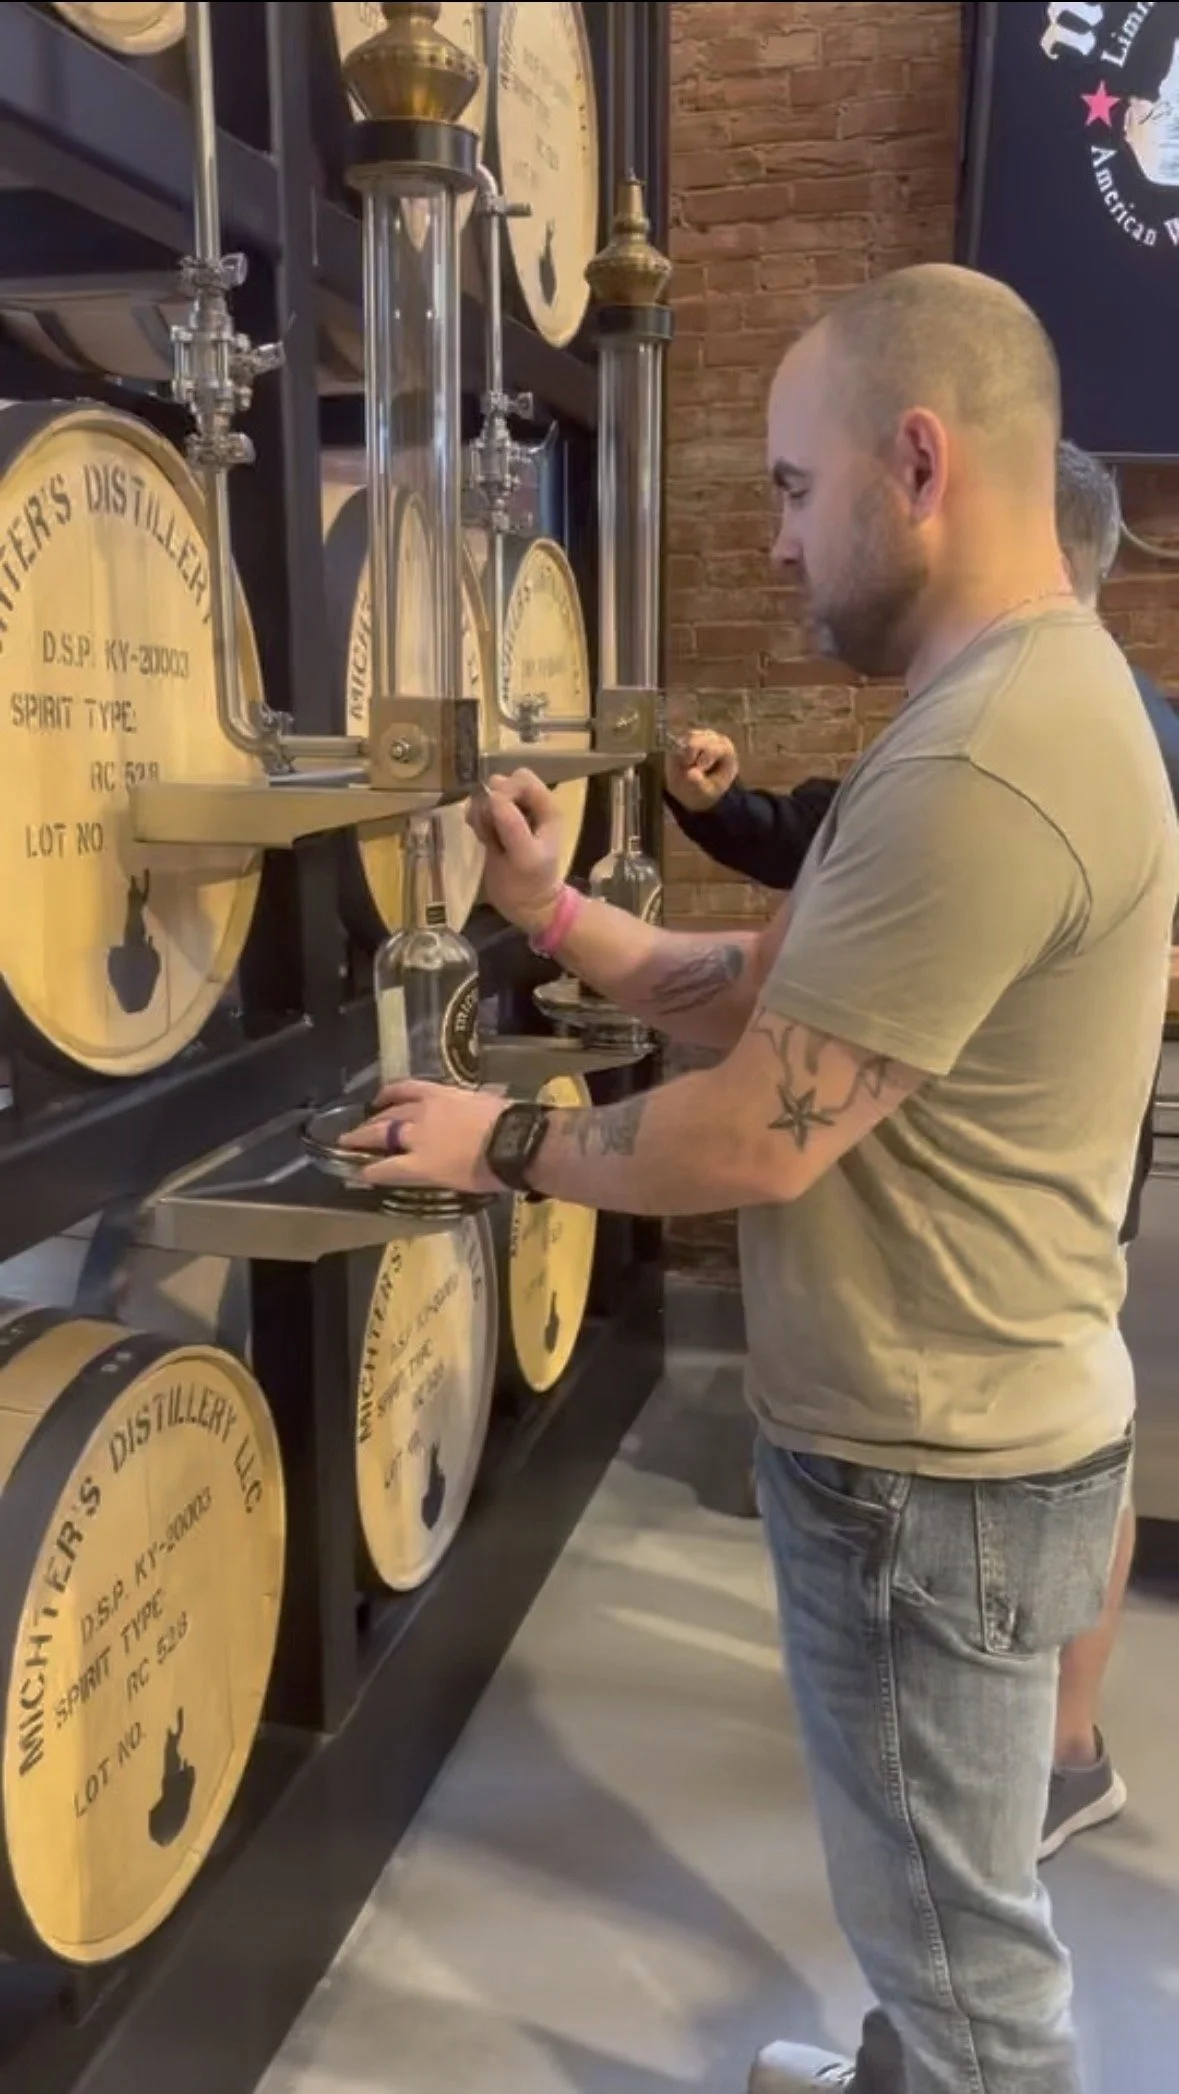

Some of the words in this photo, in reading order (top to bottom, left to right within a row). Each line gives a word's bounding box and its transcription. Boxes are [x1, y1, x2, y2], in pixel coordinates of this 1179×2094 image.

[1091, 144, 1156, 246] American
[84, 463, 212, 625] DISTILLER
[10, 692, 73, 729] SPIRIT
[90, 761, 116, 792] RC
[26, 823, 67, 858] LOT
[134, 1486, 213, 1588] KY-20003
[17, 1475, 101, 1777] MICHTER'S
[109, 1382, 237, 1474] DISTILLERY
[55, 1646, 112, 1730] SPIRIT
[126, 1656, 151, 1703] RC
[73, 1757, 111, 1819] LOT
